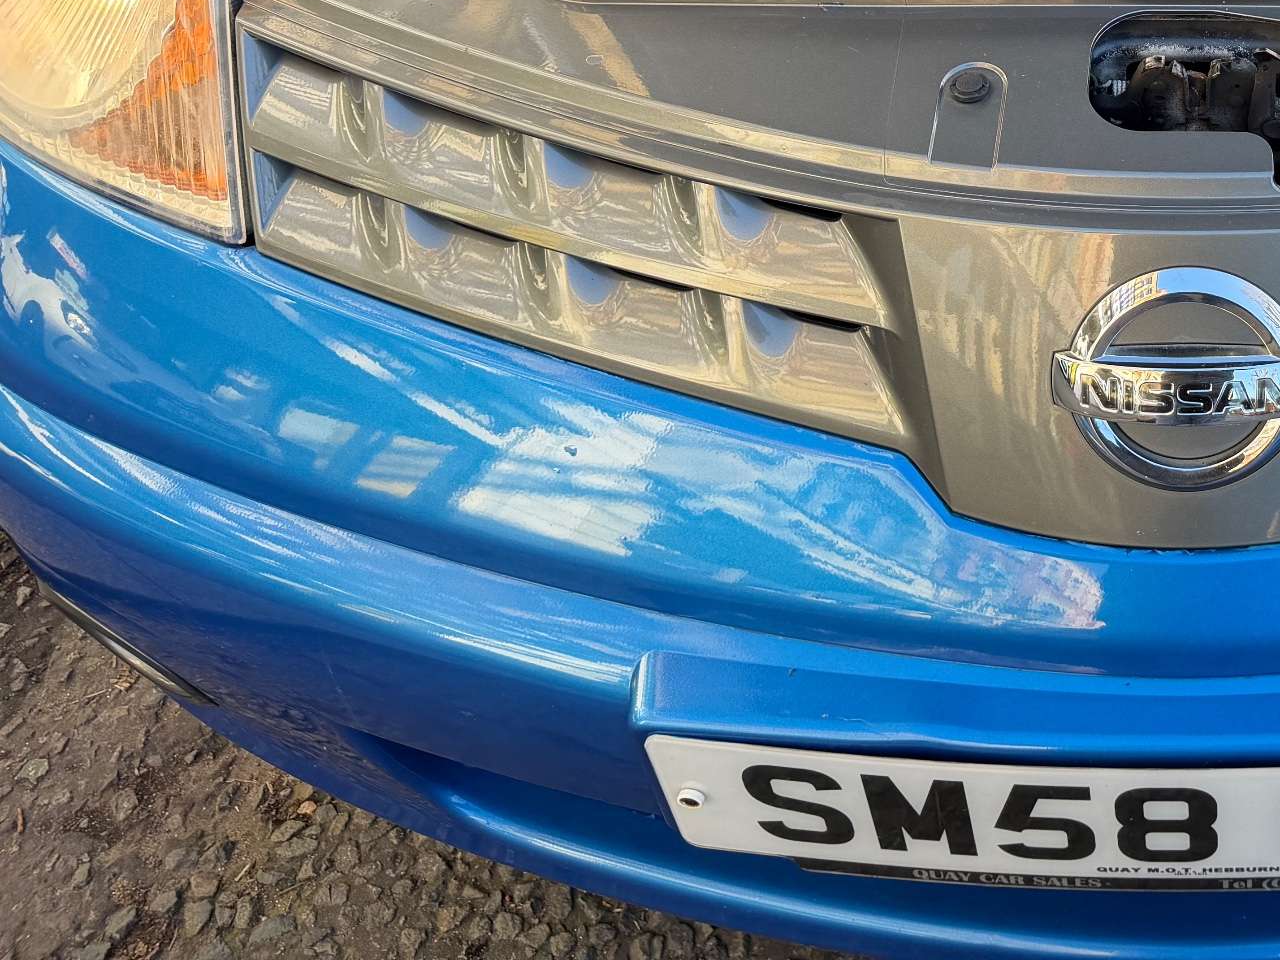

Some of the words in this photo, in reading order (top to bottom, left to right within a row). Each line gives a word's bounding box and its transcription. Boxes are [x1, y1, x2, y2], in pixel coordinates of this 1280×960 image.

[741, 763, 1219, 863] SM58
[912, 868, 972, 882] QUAY
[979, 873, 1025, 886] CAR
[1032, 876, 1101, 888] SALES
[1218, 878, 1252, 890] Tel
[1096, 866, 1141, 874] QUAY
[1202, 866, 1280, 874] HEBBURN
